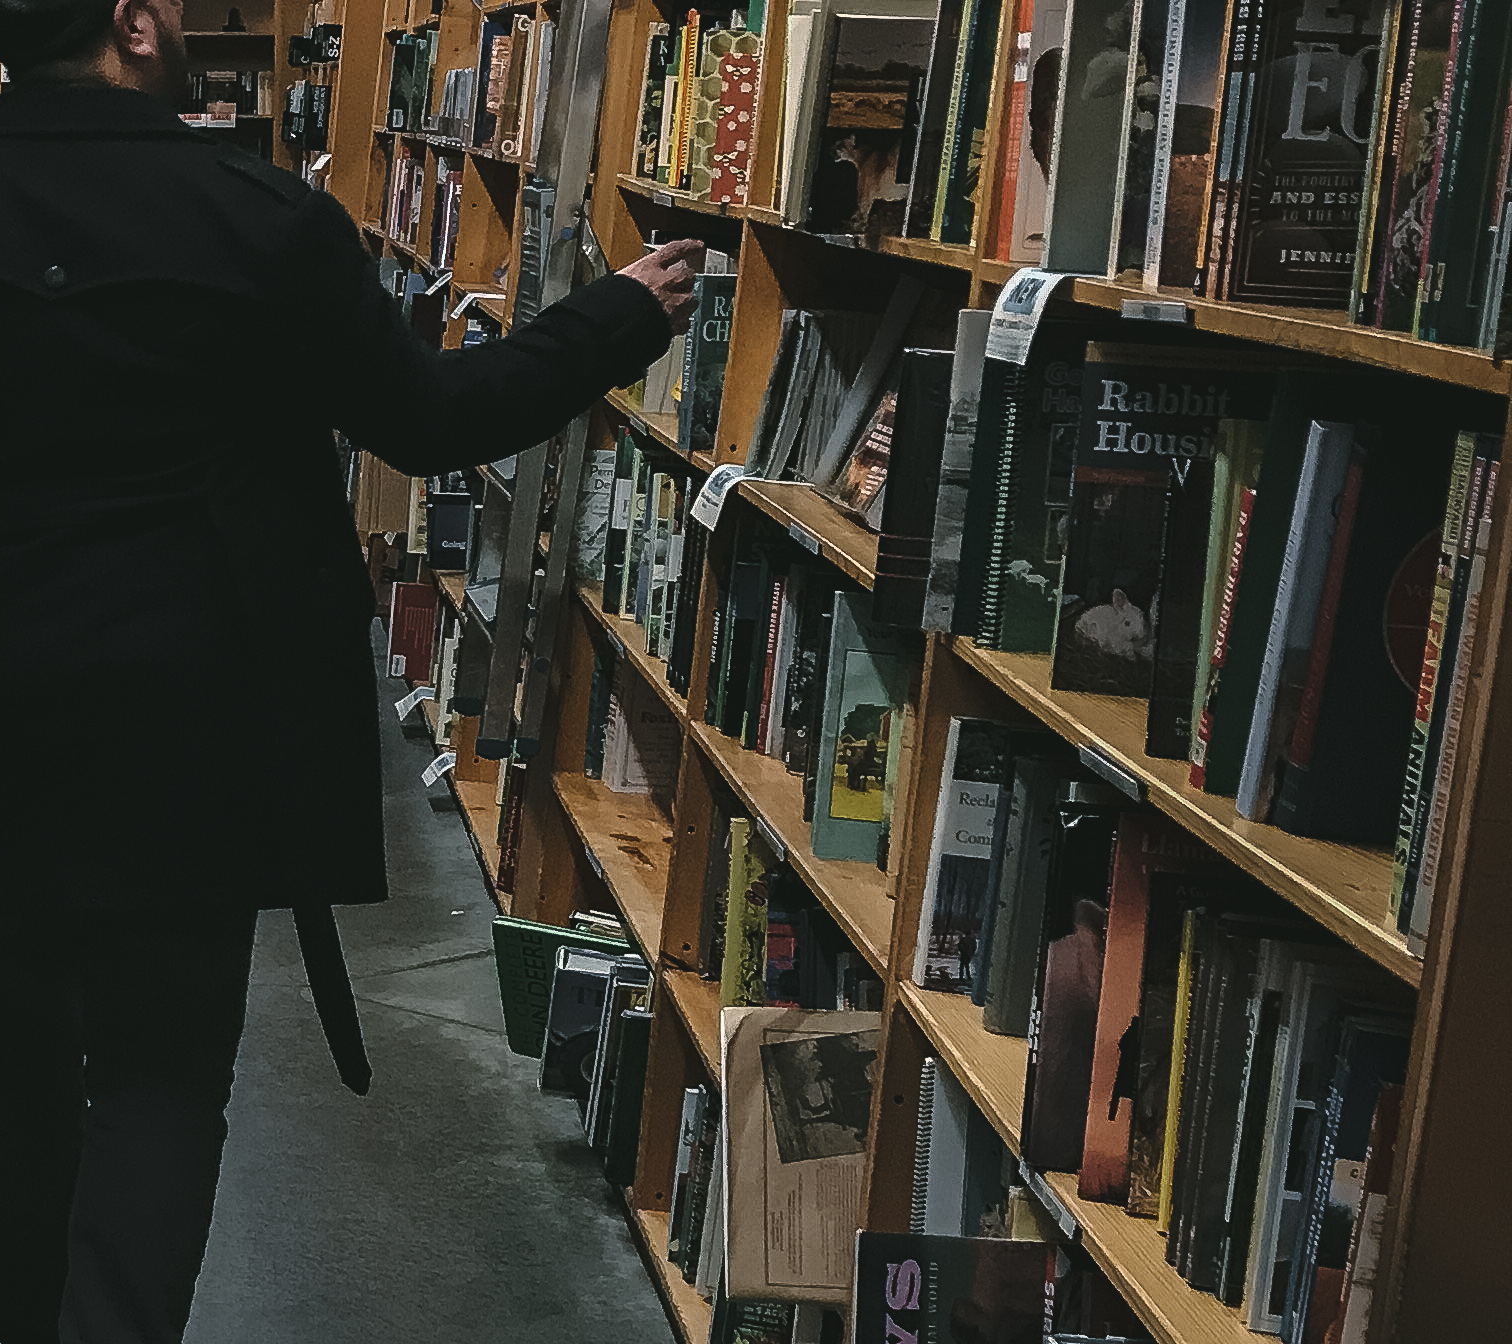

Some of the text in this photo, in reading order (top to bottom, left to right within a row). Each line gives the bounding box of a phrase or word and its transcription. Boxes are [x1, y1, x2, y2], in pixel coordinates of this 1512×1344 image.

[1270, 192, 1360, 204] AND ESS
[1282, 209, 1298, 221] TO
[1308, 210, 1332, 222] THE
[1098, 379, 1230, 418] Rabbit
[1094, 421, 1212, 457] Housi
[1396, 619, 1445, 867] FARM ANIMALS
[1425, 634, 1478, 886] WESTERN RANGE REVISITED
[521, 933, 550, 998] DEERE
[928, 1260, 940, 1314] WORLD
